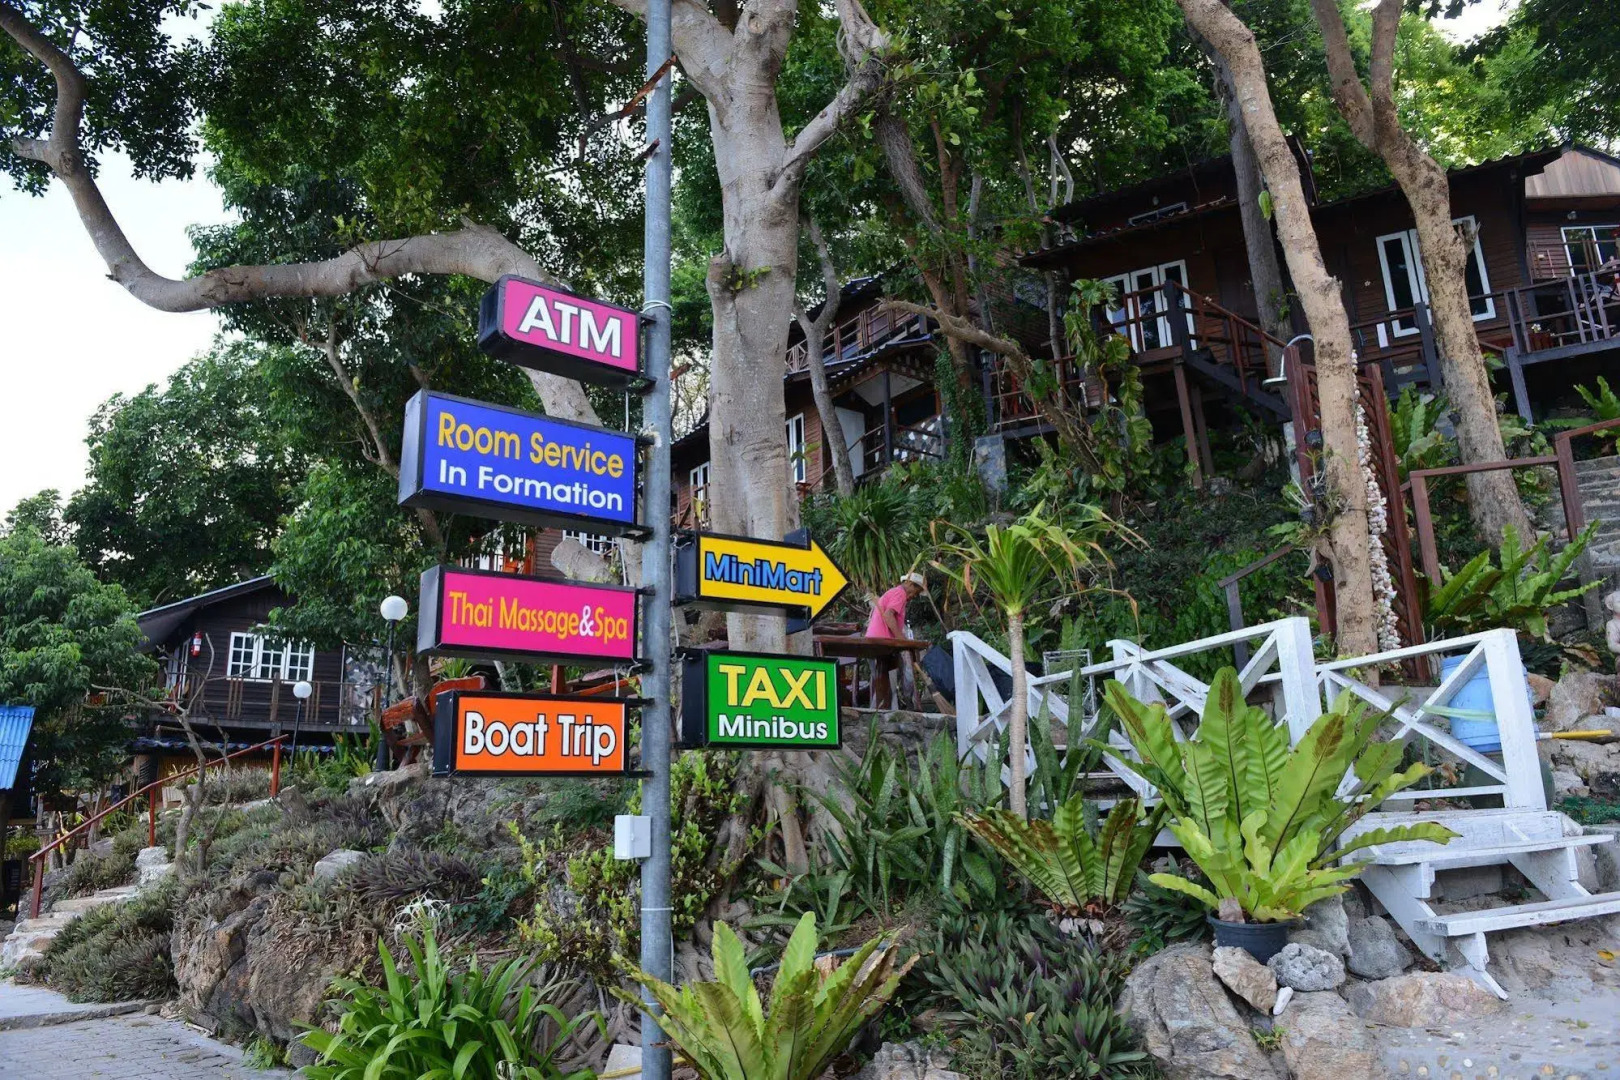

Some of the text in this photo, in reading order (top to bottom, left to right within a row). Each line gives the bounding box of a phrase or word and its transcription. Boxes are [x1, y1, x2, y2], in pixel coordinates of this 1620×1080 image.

[517, 295, 621, 358] ATM
[438, 411, 624, 479] Room Service
[439, 459, 622, 511] In Formation
[704, 551, 822, 596] MiniMart
[449, 591, 494, 628] Thai
[718, 664, 827, 710] TAXI
[463, 711, 616, 766] Boat Trip
[718, 713, 828, 740] Minibus
